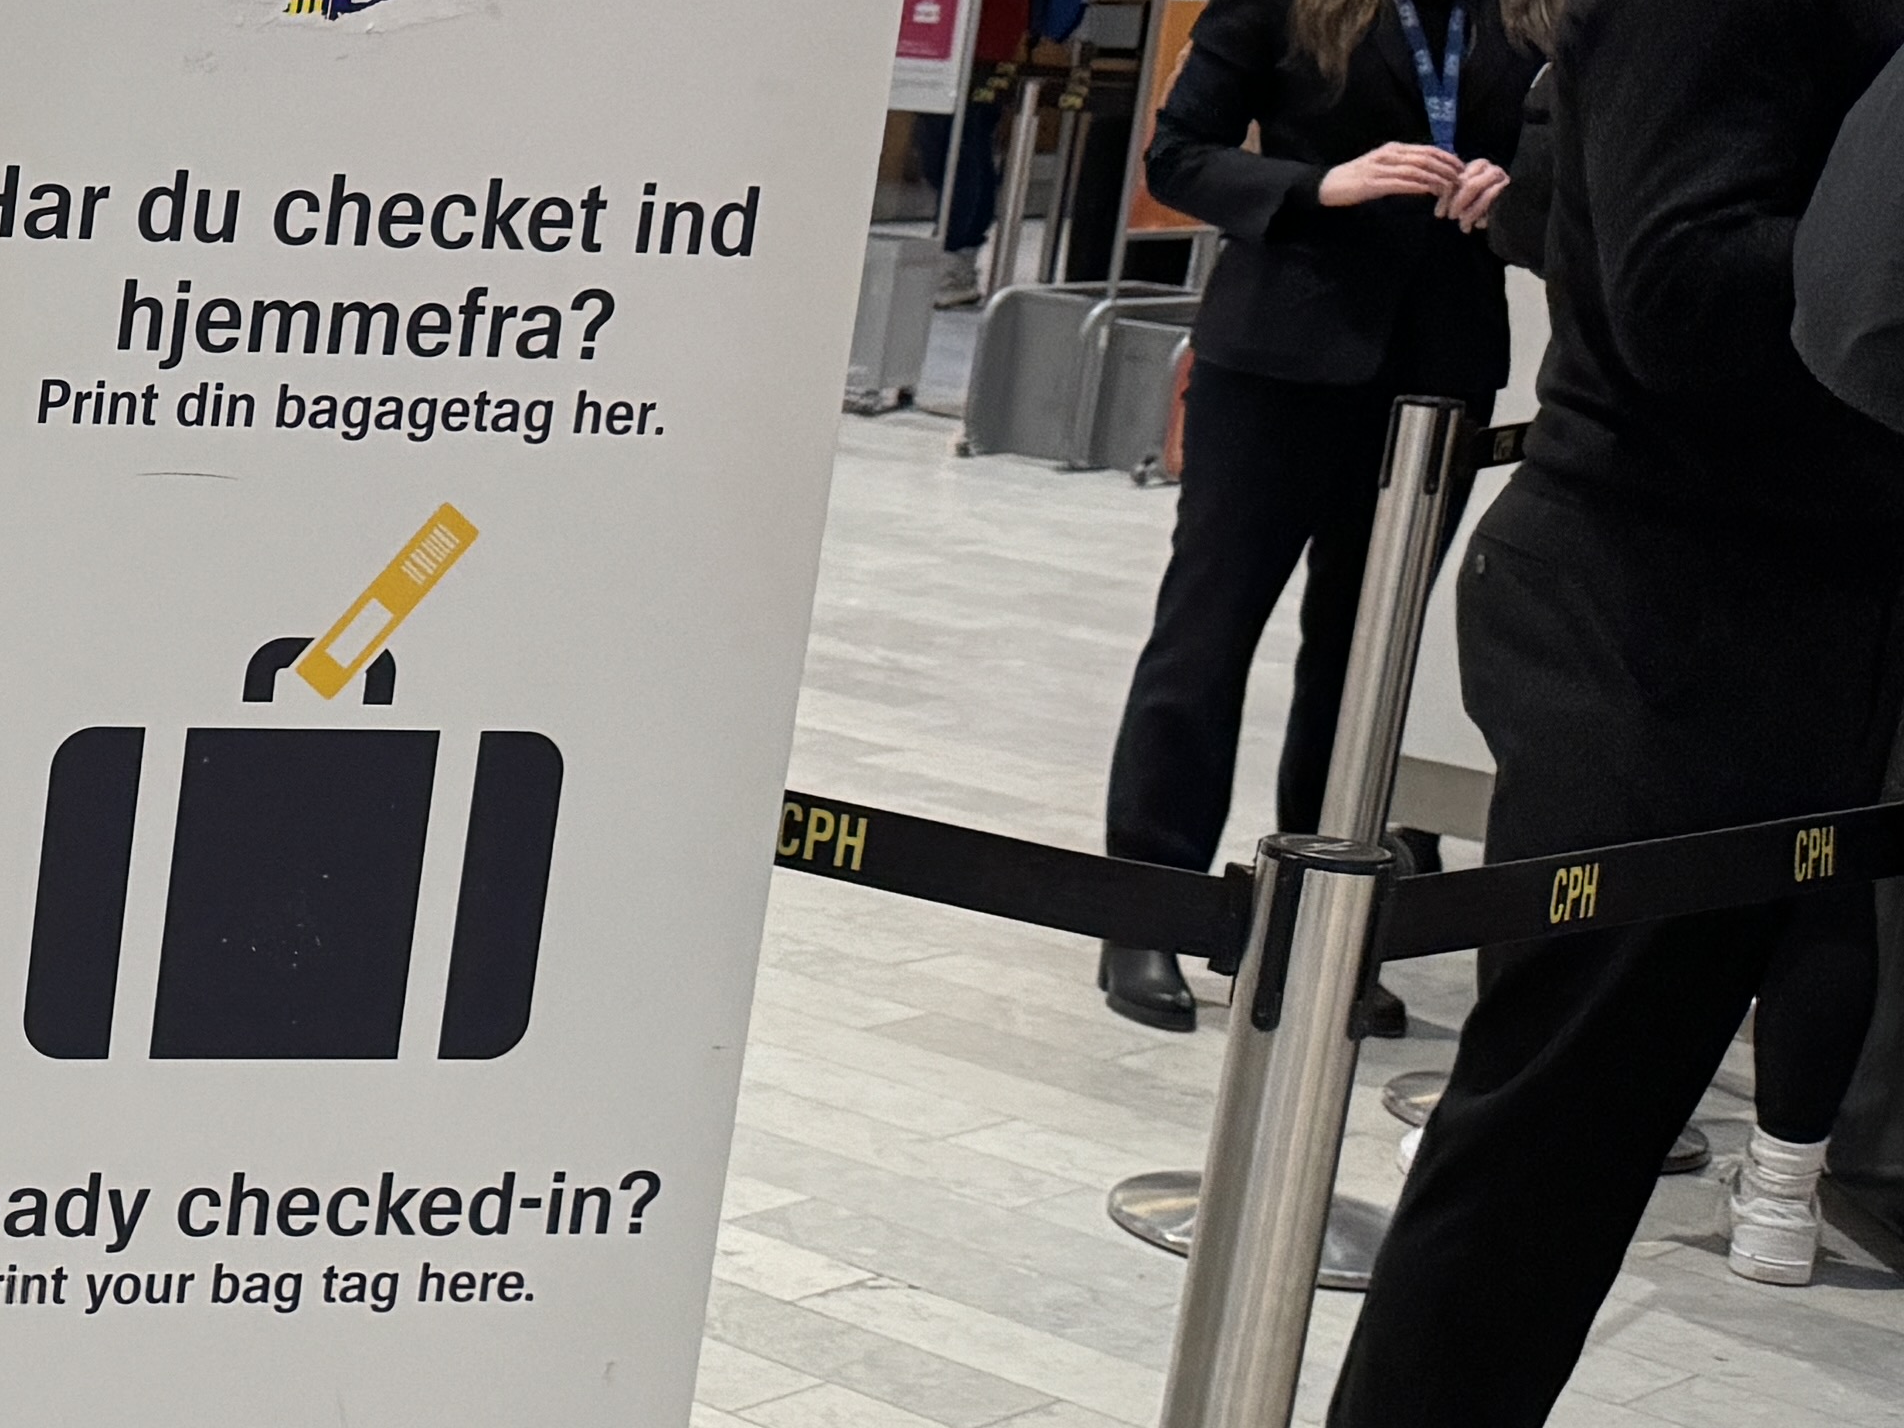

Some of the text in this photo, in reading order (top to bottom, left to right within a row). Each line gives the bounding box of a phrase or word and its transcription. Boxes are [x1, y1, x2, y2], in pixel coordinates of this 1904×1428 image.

[137, 168, 241, 244] du
[273, 178, 607, 254] checket
[633, 183, 761, 258] ind
[116, 278, 617, 370] hjemmefra?
[36, 378, 667, 445] Print din bagagetag her.
[776, 802, 869, 871] CPH
[1793, 825, 1835, 882] CPH
[1549, 863, 1599, 924] CPH
[177, 1170, 663, 1239] checked-in?
[84, 1269, 195, 1314] your
[210, 1263, 303, 1313] bag
[322, 1265, 399, 1313] tag
[416, 1262, 536, 1304] here.
